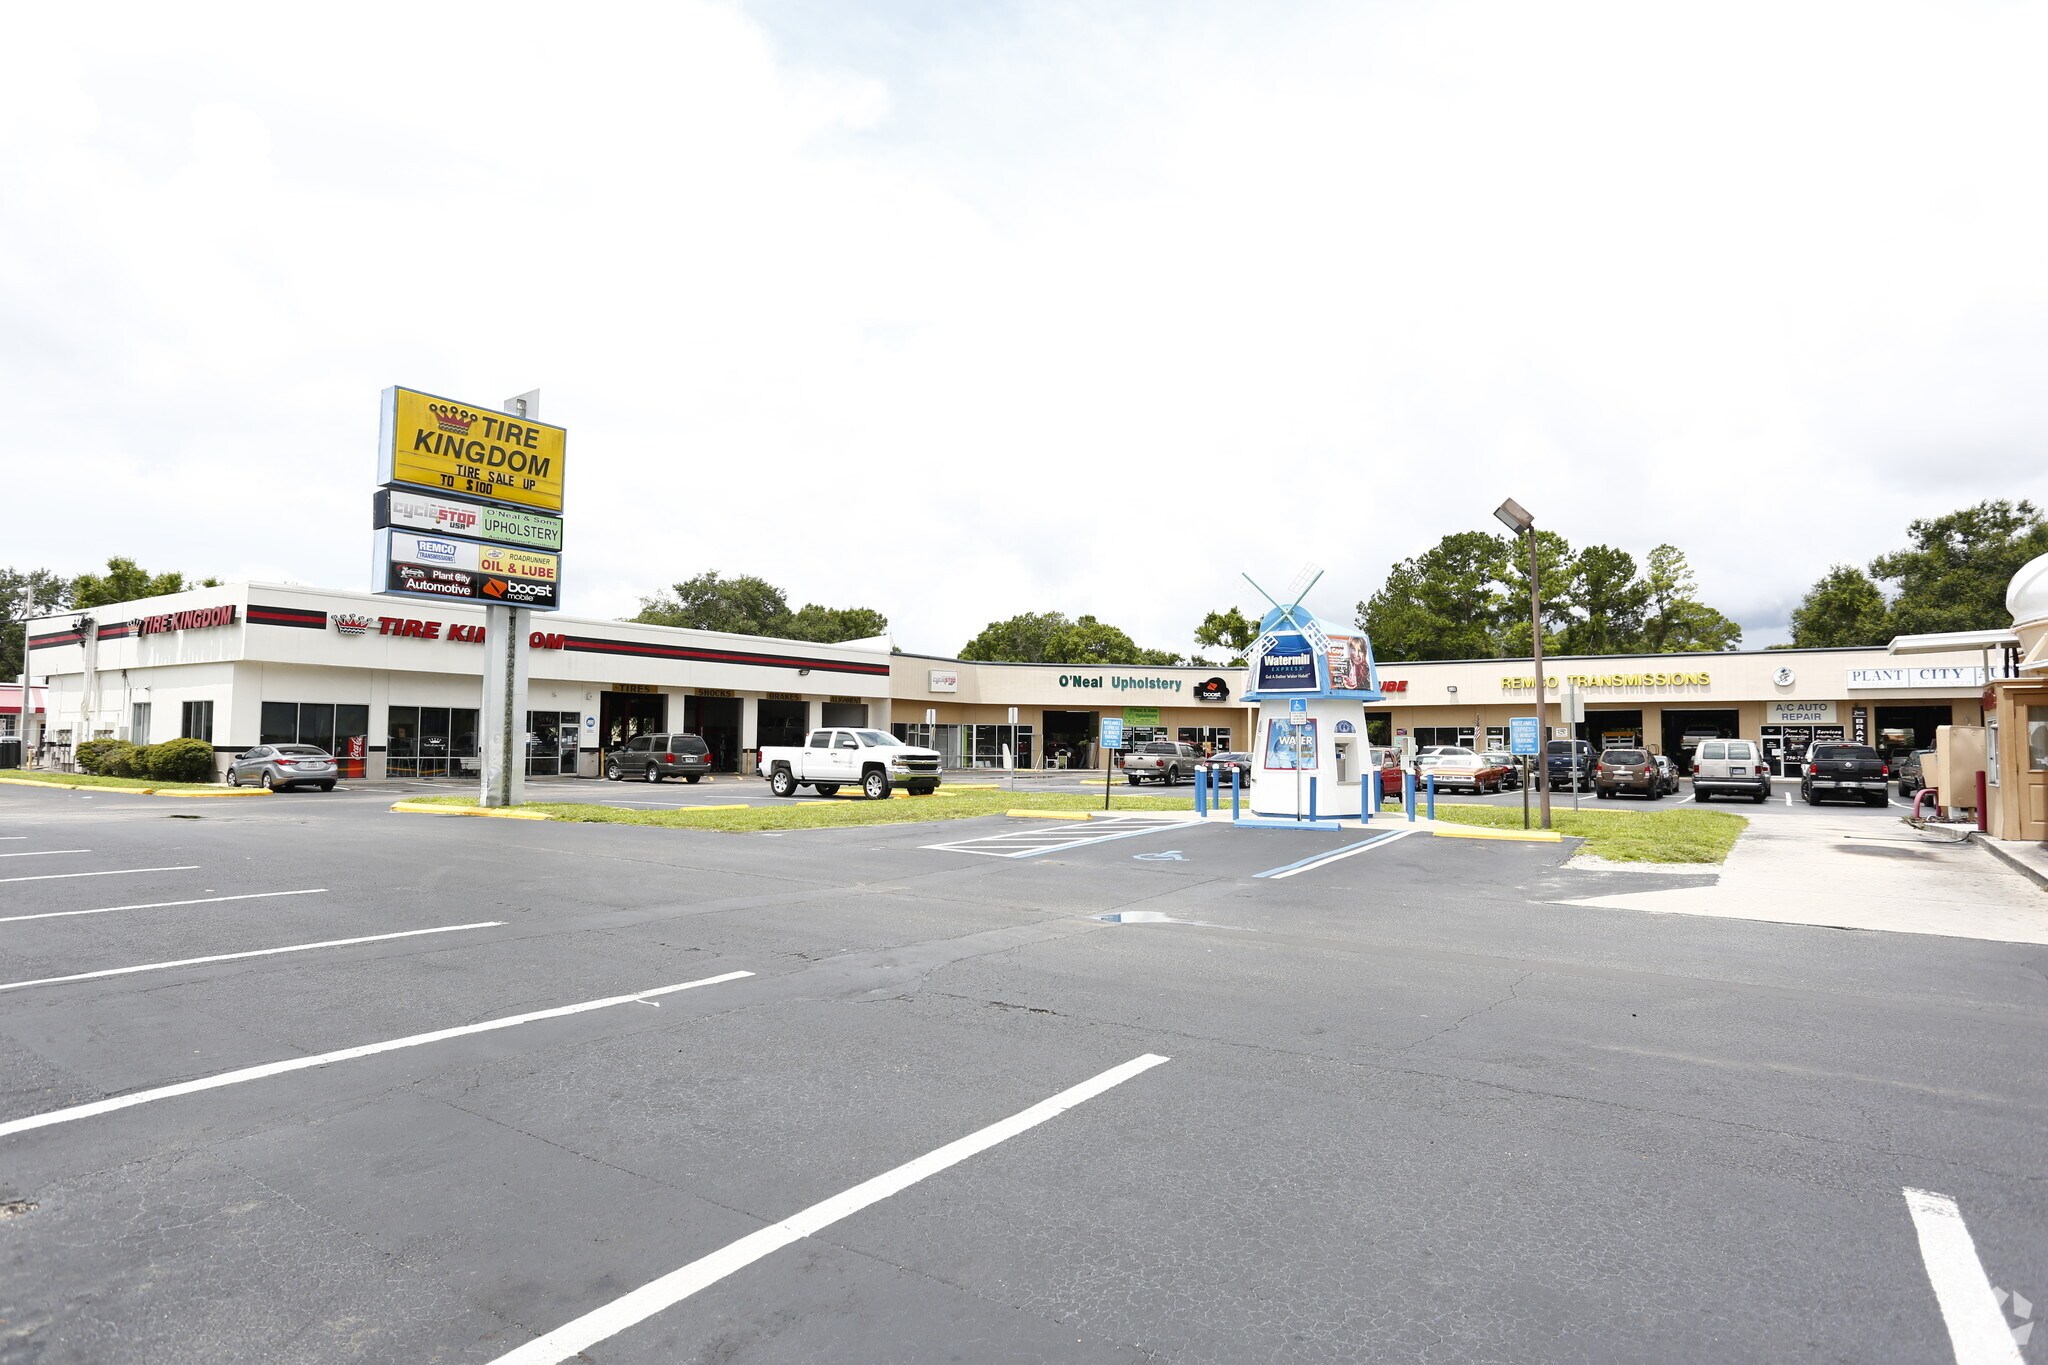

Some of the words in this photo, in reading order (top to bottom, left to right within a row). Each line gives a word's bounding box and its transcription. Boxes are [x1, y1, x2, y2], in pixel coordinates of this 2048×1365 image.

[482, 416, 540, 449] TIRE
[414, 428, 550, 478] KINGDOM
[440, 474, 454, 487] TO
[466, 480, 492, 495] $100
[456, 464, 480, 480] TIRE
[488, 471, 514, 487] SALE
[523, 478, 536, 490] UP
[487, 509, 520, 520] O'Neal
[534, 518, 558, 526] Sons
[450, 522, 466, 530] USA
[484, 518, 558, 541] UPHOLSTERY
[420, 542, 454, 554] REMCO
[420, 552, 454, 562] TRANSMISSIONS
[509, 554, 550, 565] ROADRUNNER
[433, 570, 454, 580] Plant
[455, 573, 470, 584] City
[482, 560, 503, 572] OIL
[508, 563, 516, 574] &
[522, 564, 554, 578] LUBE
[406, 578, 470, 595] Automotive
[508, 580, 552, 597] boost
[507, 593, 534, 602] mobile
[143, 614, 170, 634] TIRE
[171, 605, 236, 630] KINGDOM
[378, 616, 442, 639] TIRE
[447, 624, 565, 650] KINOM
[1264, 653, 1310, 666] Watermill
[1567, 672, 1711, 688] TRANSMISSIONS
[1852, 670, 1903, 682] PLANT
[1920, 668, 1964, 680] CITY
[620, 684, 650, 693] TIRES
[1058, 675, 1103, 688] O'Neal
[1112, 676, 1182, 692] Upholstery
[698, 688, 731, 698] SHOCKS
[769, 692, 800, 700] BRAKES
[830, 696, 861, 704] ALIGNMENT
[1856, 718, 1864, 743] BRAK
[1279, 736, 1312, 745] WAER
